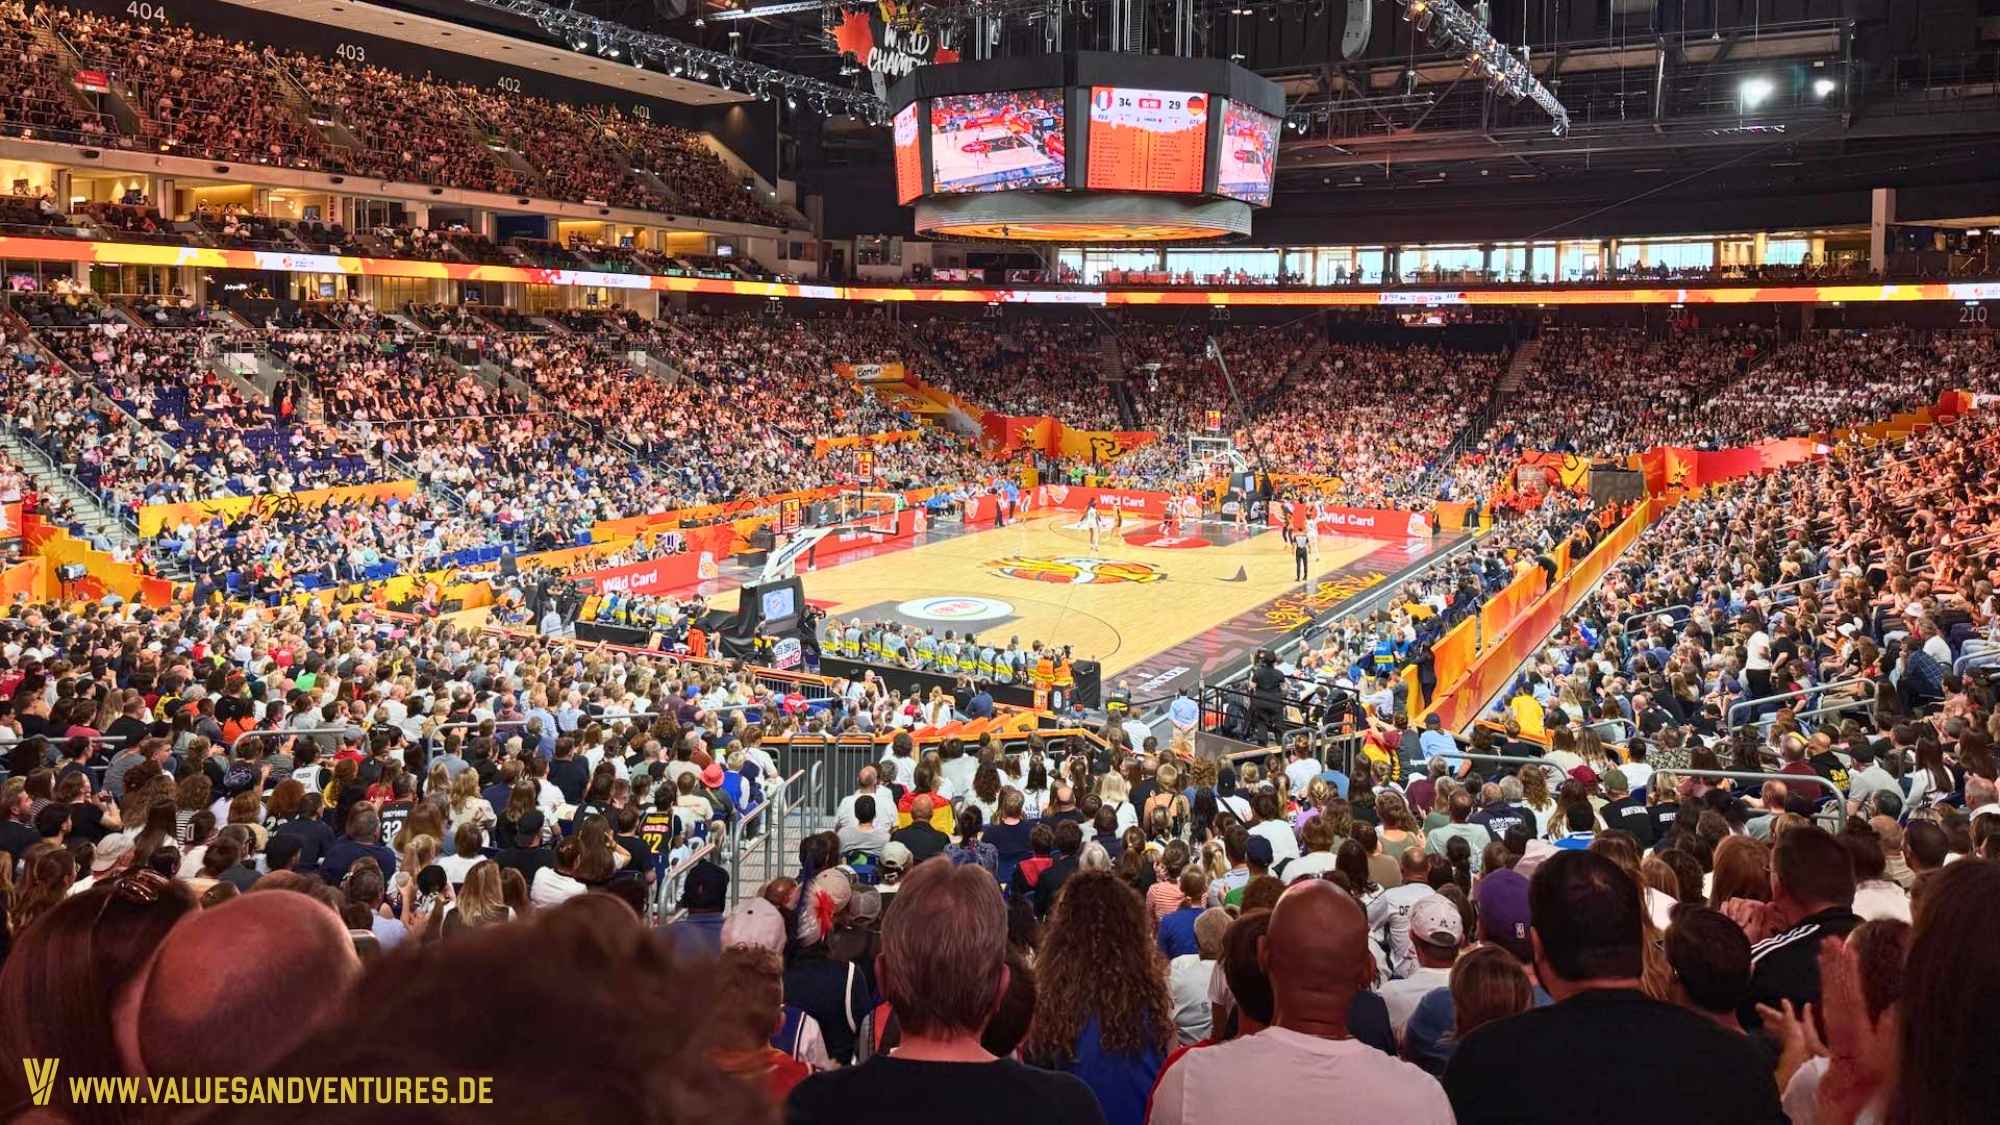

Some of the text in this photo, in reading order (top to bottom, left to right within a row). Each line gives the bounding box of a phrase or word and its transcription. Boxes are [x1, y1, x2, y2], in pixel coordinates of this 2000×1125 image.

[126, 1, 165, 22] 404
[336, 43, 365, 61] 403
[498, 76, 521, 93] 402
[1119, 98, 1131, 107] 34
[1168, 101, 1181, 110] 29
[632, 104, 650, 120] 401
[1960, 306, 1987, 323] 210
[1122, 495, 1145, 508] Card
[1347, 514, 1375, 527] Card
[602, 570, 657, 593] Wild Card
[382, 820, 402, 843] 32
